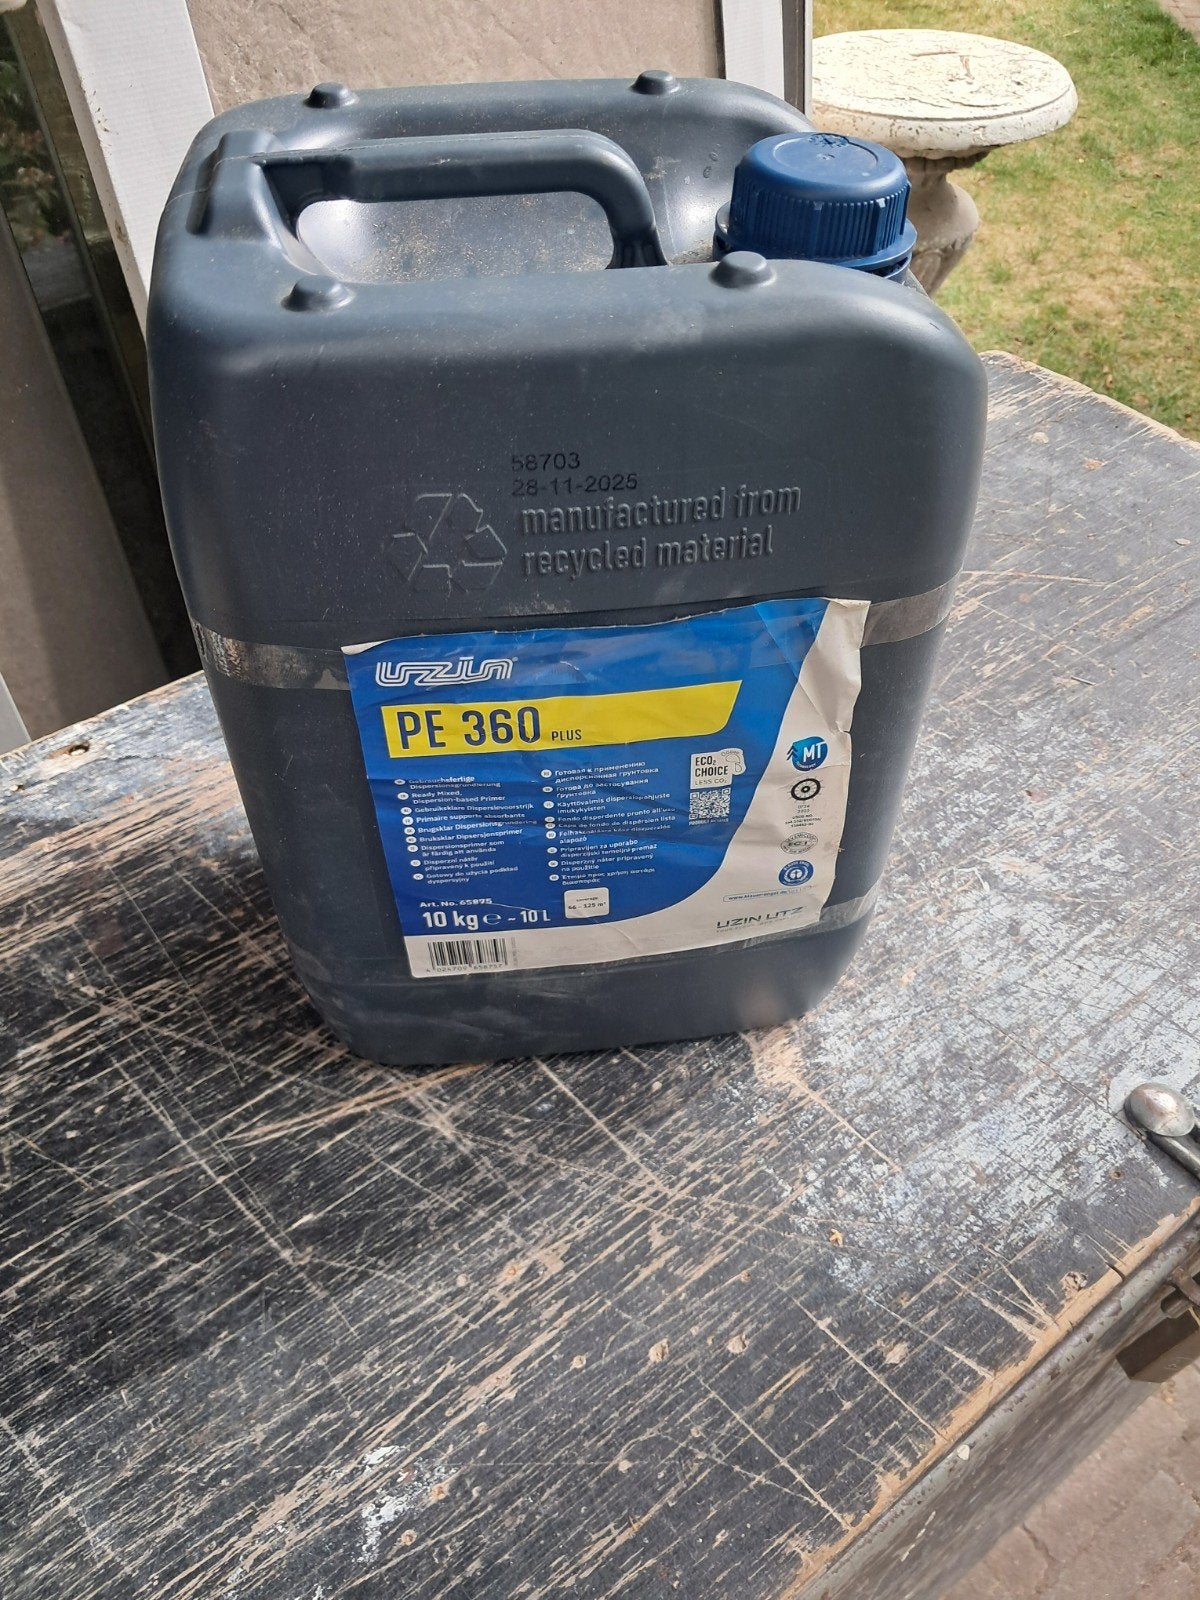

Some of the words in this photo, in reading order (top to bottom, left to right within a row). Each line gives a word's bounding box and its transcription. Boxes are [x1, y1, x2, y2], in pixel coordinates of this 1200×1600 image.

[511, 452, 581, 472] 58703
[511, 473, 638, 497] 28-11-2025
[521, 486, 726, 534] manufactured
[734, 484, 801, 518] from
[522, 537, 647, 579] recycled
[656, 524, 774, 568] material
[396, 709, 447, 750] PE
[461, 706, 541, 747] 360
[551, 729, 582, 741] PLUS
[803, 741, 828, 763] MT
[694, 765, 729, 778] CHOICE
[694, 778, 712, 786] LESS
[414, 805, 465, 813] Gebruiksklare
[627, 809, 651, 817] pronto
[416, 815, 449, 823] Primaire
[418, 824, 453, 834] Brugsklar
[609, 839, 639, 849] uporabo
[631, 843, 658, 853] premaz
[419, 900, 440, 908] Art.
[459, 898, 493, 906] 65875
[422, 911, 448, 928] 10
[453, 911, 479, 930] kg
[520, 909, 538, 924] 10
[542, 909, 551, 922] L
[716, 915, 762, 929] UZIN
